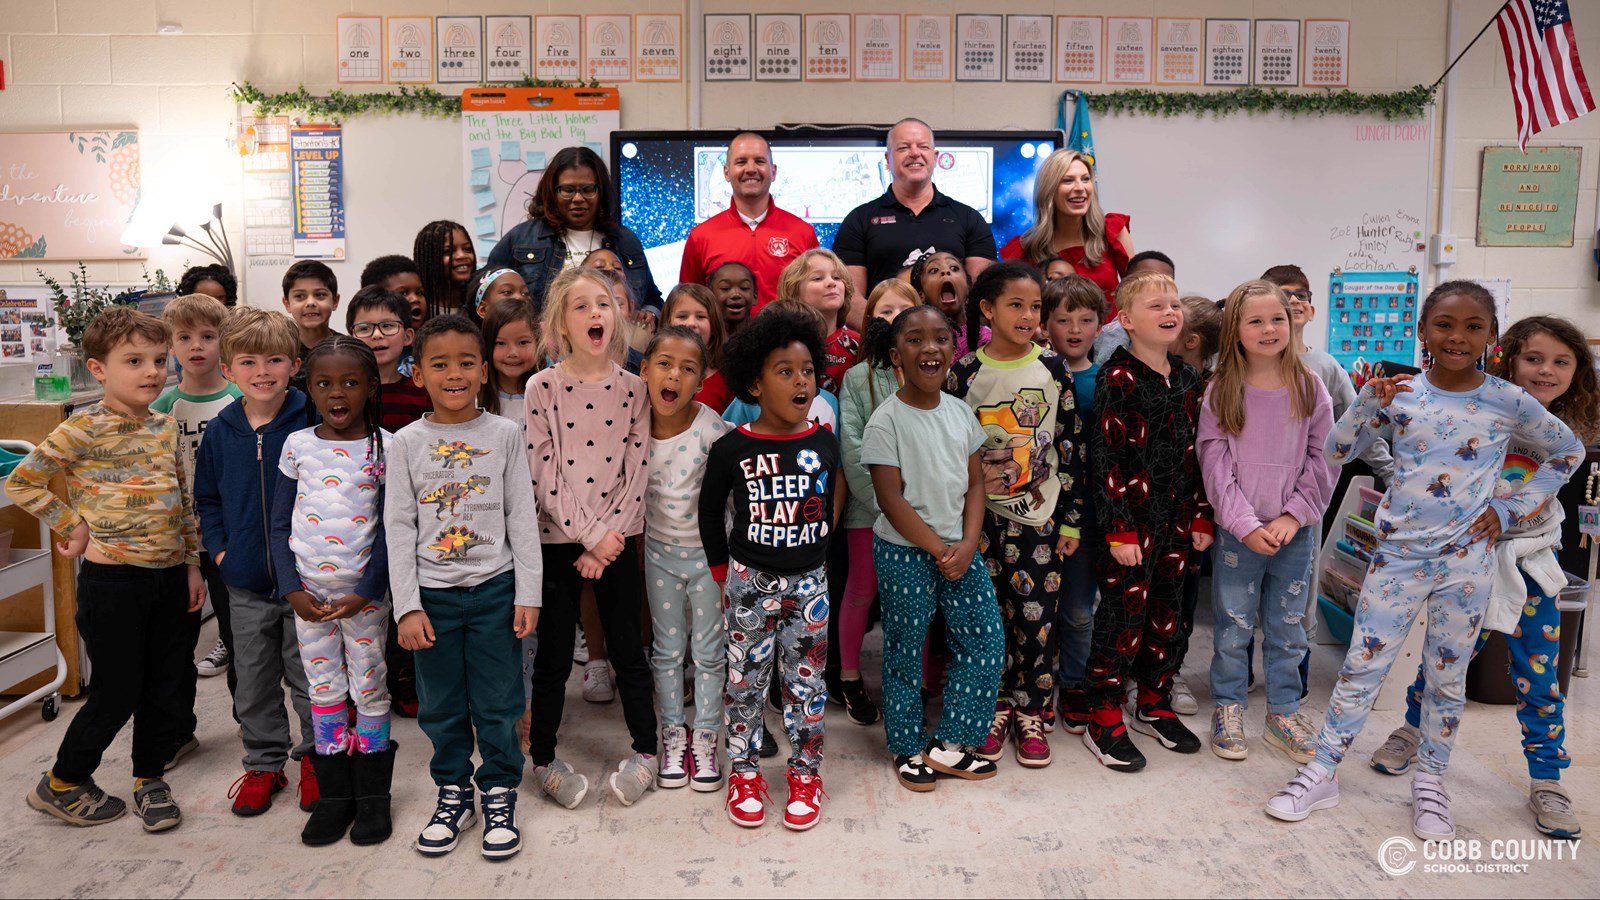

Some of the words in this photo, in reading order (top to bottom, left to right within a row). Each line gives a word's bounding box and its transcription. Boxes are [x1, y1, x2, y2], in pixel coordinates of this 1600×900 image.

[355, 24, 363, 47] 1
[401, 24, 418, 47] 2
[451, 23, 466, 46] 3
[500, 23, 518, 46] 4
[551, 22, 565, 43] 5
[601, 22, 616, 44] 6
[649, 20, 667, 44] 7
[720, 22, 735, 43] 8
[772, 21, 786, 42] 9
[818, 20, 840, 44] 10
[920, 18, 941, 39] 12
[971, 18, 988, 39] 13
[1020, 20, 1041, 40] 14
[1072, 20, 1090, 41] 15
[1122, 22, 1140, 42] 16
[1171, 22, 1191, 42] 17
[1271, 23, 1287, 44] 19
[1315, 25, 1342, 45] 20
[547, 45, 569, 57] five
[713, 44, 743, 58] eight
[767, 46, 790, 56] nine
[818, 45, 838, 55] ten
[865, 40, 890, 48] eleven
[916, 41, 941, 49] twelve
[964, 41, 995, 50] thirteen
[1012, 41, 1047, 50] fourteen
[1065, 42, 1094, 50] fifteen
[1160, 45, 1198, 53] seventeen
[1212, 46, 1244, 55] eighteen
[1314, 47, 1341, 55] twenty
[350, 50, 369, 58] one
[400, 48, 421, 58] two
[444, 47, 475, 58] three
[495, 46, 522, 58] four
[600, 47, 616, 57] six
[642, 47, 675, 56] seven
[465, 114, 487, 127] The
[492, 114, 523, 127] Three
[529, 113, 559, 125] Little
[565, 113, 598, 125] Wolves
[469, 128, 491, 141] and
[496, 129, 512, 140] the
[520, 128, 537, 143] Big
[541, 126, 562, 139] Bad
[570, 127, 586, 143] Pig
[1356, 124, 1390, 141] LUNCH
[1395, 123, 1428, 140] PARTY
[294, 151, 324, 160] LEVEL
[325, 151, 339, 160] UP
[1362, 212, 1391, 225] Cullen
[1396, 209, 1420, 225] Emma
[1357, 225, 1395, 238] Hunter
[1360, 239, 1389, 254] Finley
[1395, 230, 1414, 253] Ruby
[1345, 259, 1399, 271] Lochlan
[1513, 446, 1528, 455] AND
[740, 454, 780, 479] EAT
[422, 470, 454, 480] TRICERATOPS
[746, 475, 810, 501] SLEEP
[464, 502, 501, 512] TYRANNOSAURUS
[749, 501, 800, 524] PLAY
[463, 513, 473, 521] REX
[1527, 514, 1545, 527] TIME
[747, 522, 819, 548] REPEAT
